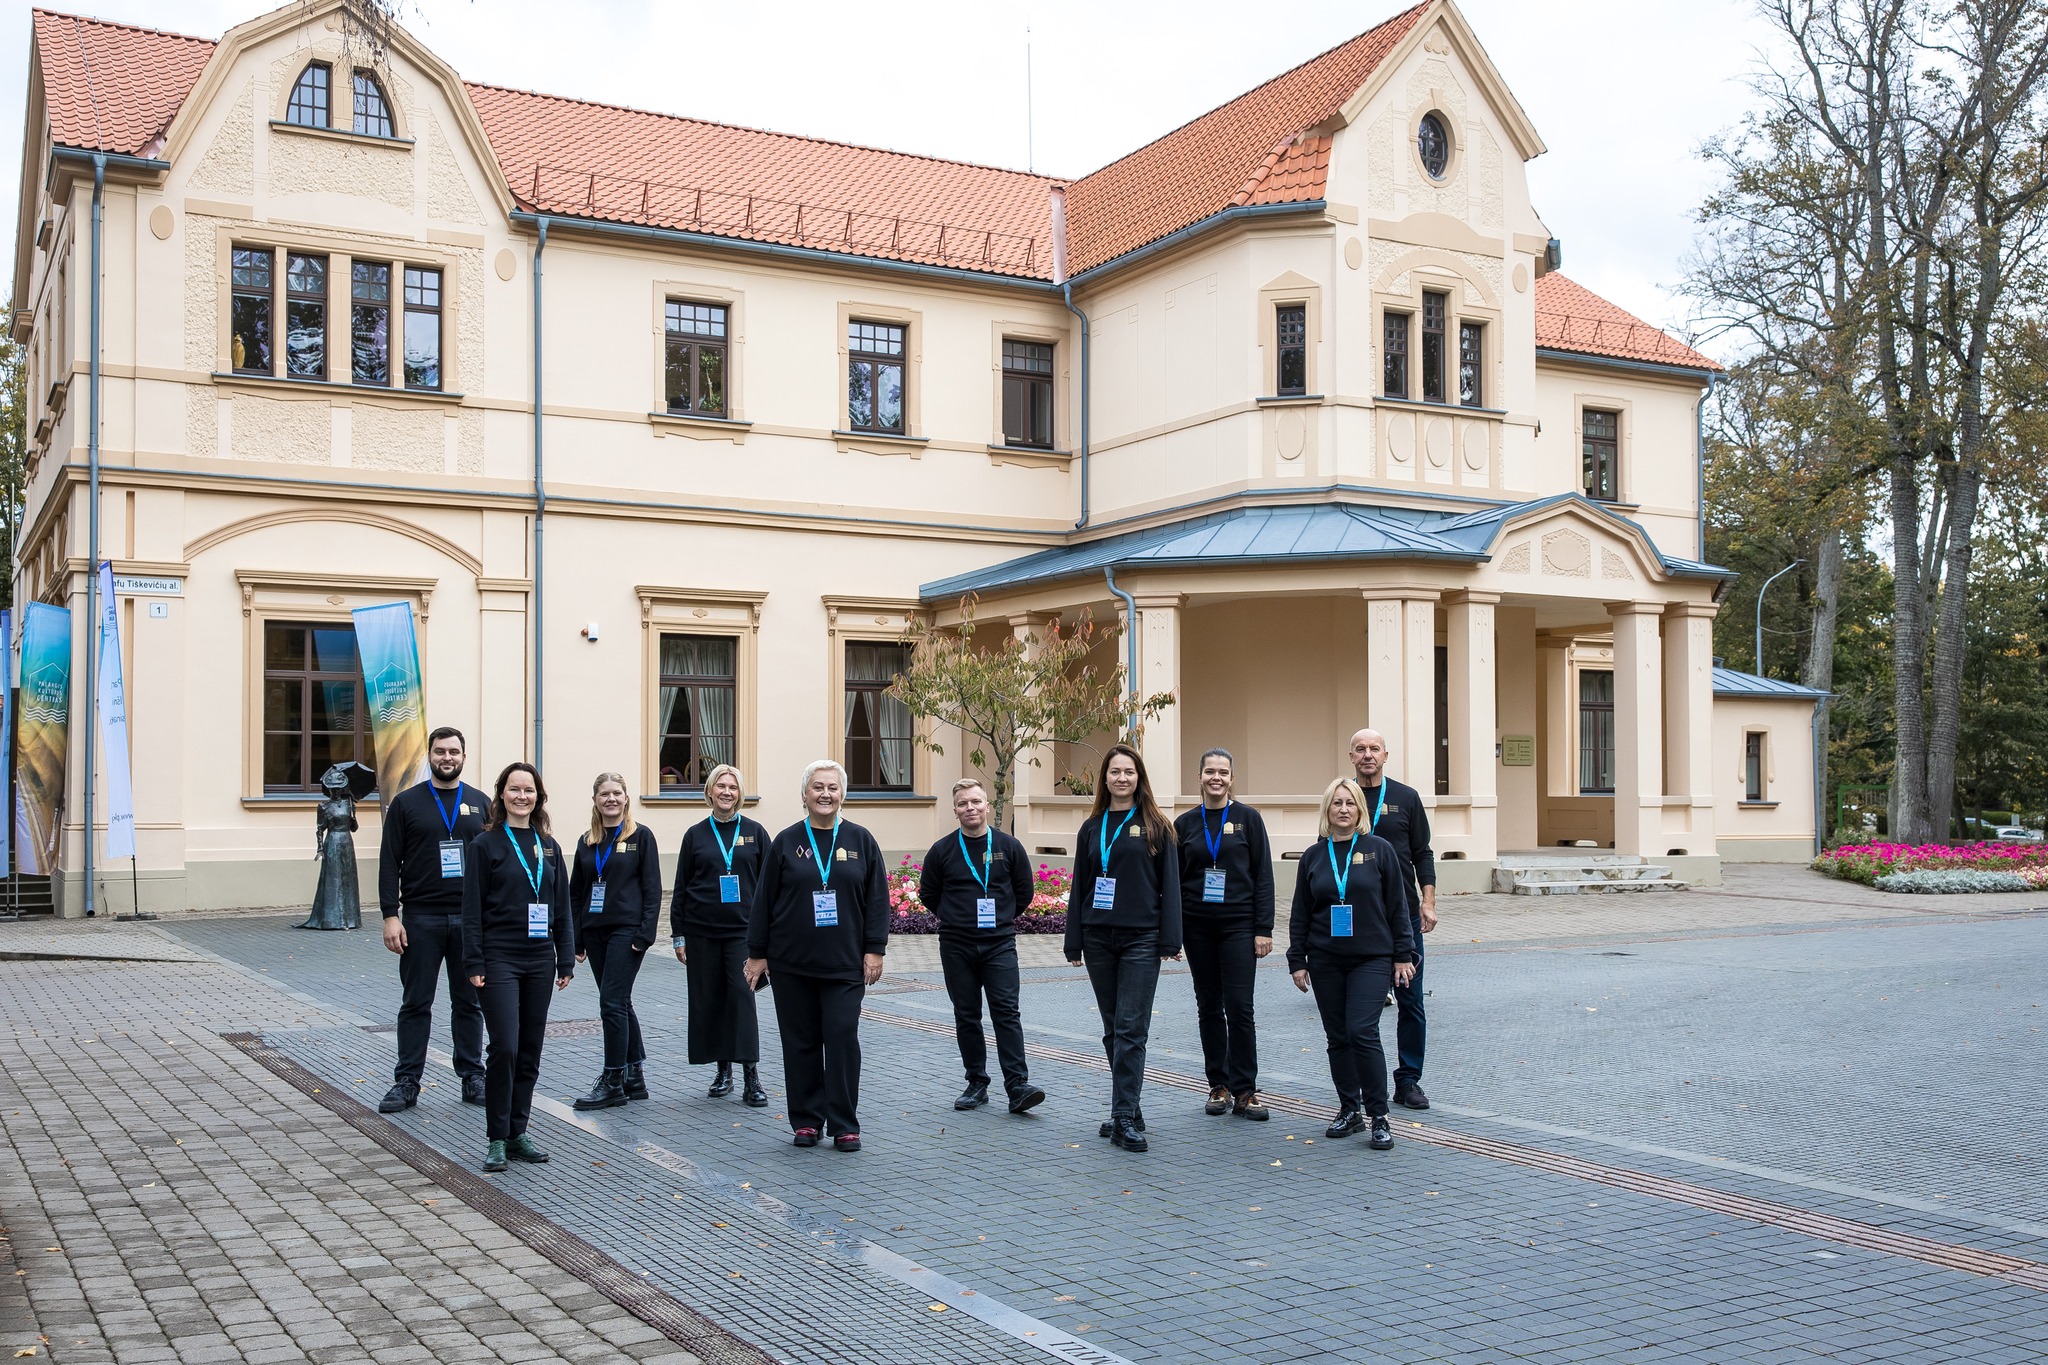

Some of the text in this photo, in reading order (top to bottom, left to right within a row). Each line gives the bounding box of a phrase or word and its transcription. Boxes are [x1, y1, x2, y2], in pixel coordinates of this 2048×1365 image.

[127, 580, 167, 590] Tiškevičių
[169, 582, 179, 590] al.
[38, 681, 62, 689] PALANGOS
[37, 695, 62, 703] CENTRAS
